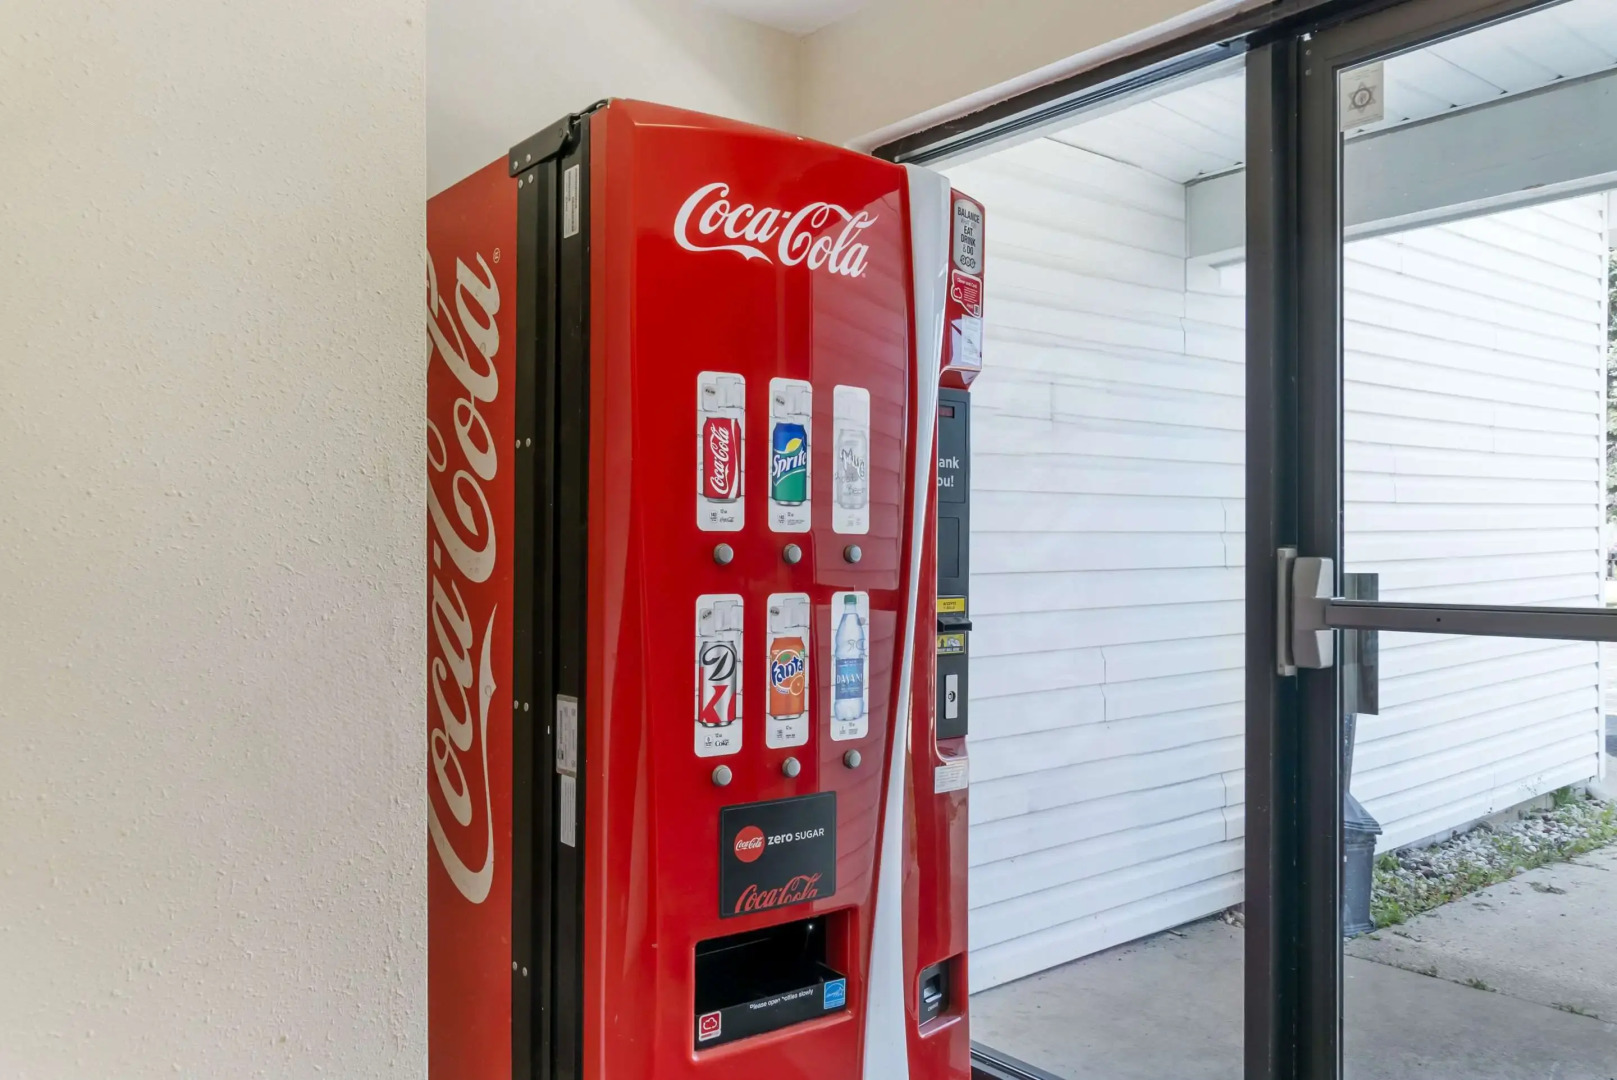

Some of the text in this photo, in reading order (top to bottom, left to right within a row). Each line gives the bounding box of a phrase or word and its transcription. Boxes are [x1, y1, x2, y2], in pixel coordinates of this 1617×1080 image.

[957, 206, 980, 224] BALANCE
[674, 182, 879, 278] Coca-Cola
[960, 233, 976, 247] DRINK
[963, 226, 973, 236] EAT
[710, 422, 729, 495] Coca-Cola
[772, 449, 807, 478] Sprite
[771, 655, 804, 688] Fanta
[736, 828, 825, 851] Coca-Cola zero SUGAR
[735, 873, 823, 914] Coca-Cola
[768, 998, 781, 1006] open
[798, 989, 814, 998] slowly
